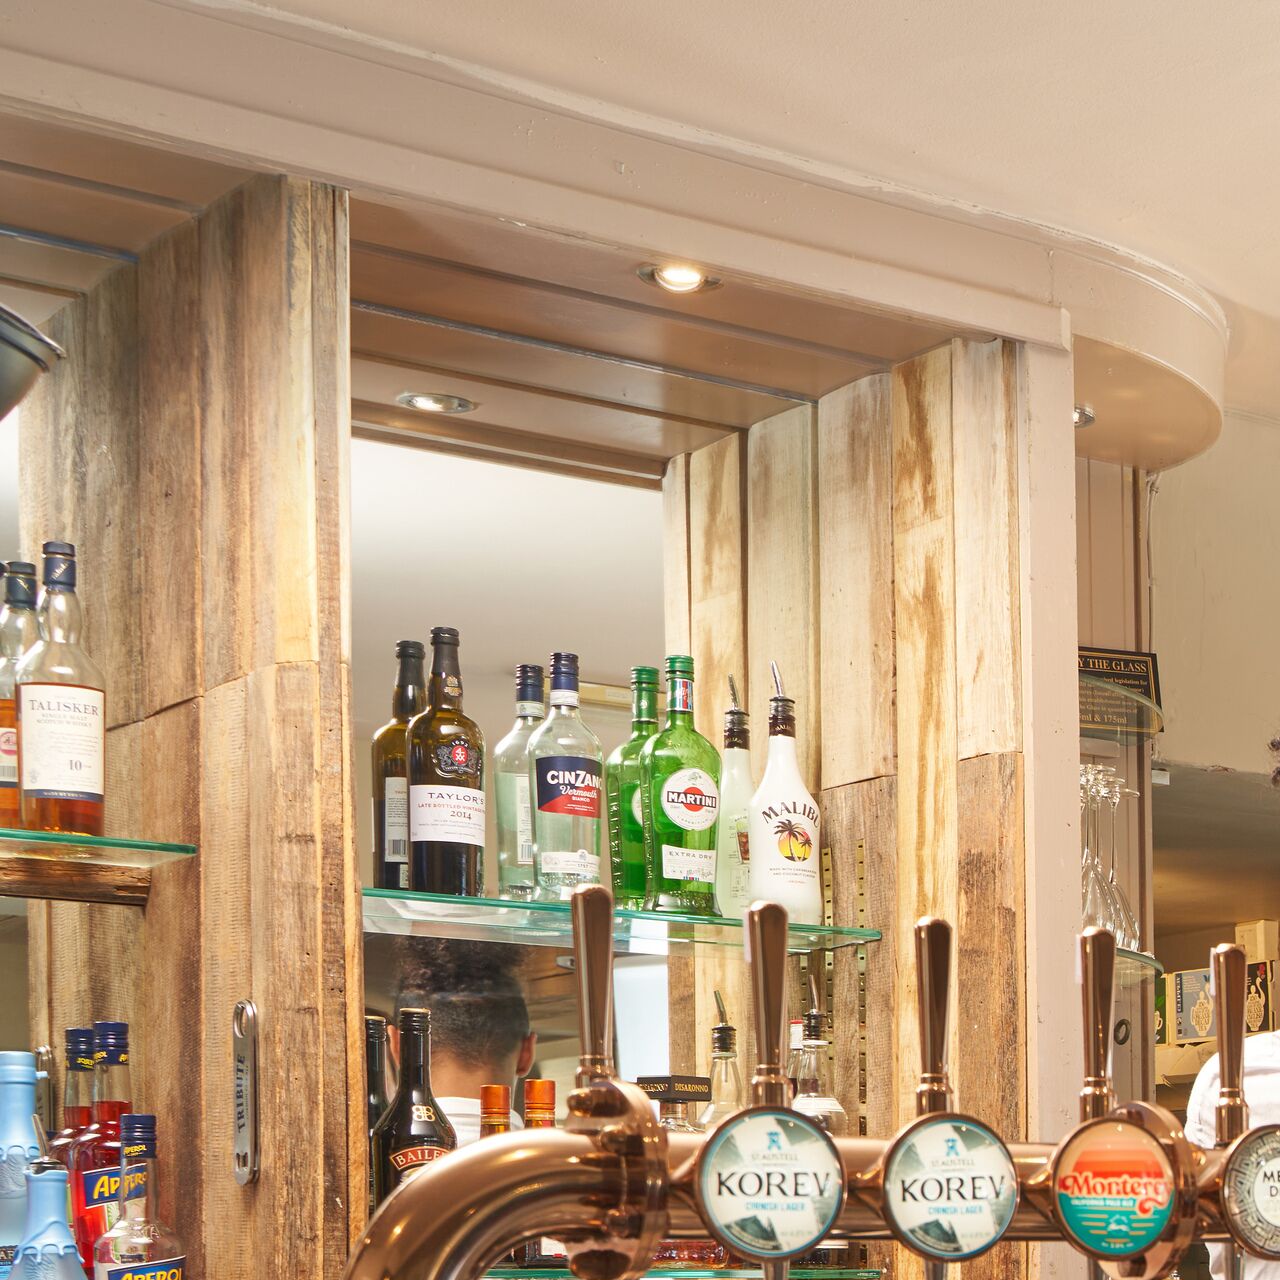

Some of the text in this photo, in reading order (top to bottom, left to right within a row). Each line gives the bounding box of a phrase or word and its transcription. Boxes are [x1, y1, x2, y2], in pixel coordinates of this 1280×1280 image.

[1088, 658, 1111, 670] THE
[1113, 660, 1147, 673] GLASS
[29, 699, 99, 716] TALISKER
[69, 760, 82, 771] 10
[428, 793, 485, 805] TAYLOR'S
[560, 785, 597, 799] Vermouth
[667, 791, 717, 808] MARTINI
[450, 811, 472, 820] 2014
[669, 850, 696, 859] EXTRA
[236, 1055, 246, 1134] TRIBUTE
[674, 1082, 709, 1093] DISARONNO
[124, 1144, 148, 1155] APEROL
[396, 1150, 448, 1166] BAILE
[717, 1171, 831, 1197] KOREV
[901, 1175, 1005, 1202] KOREV
